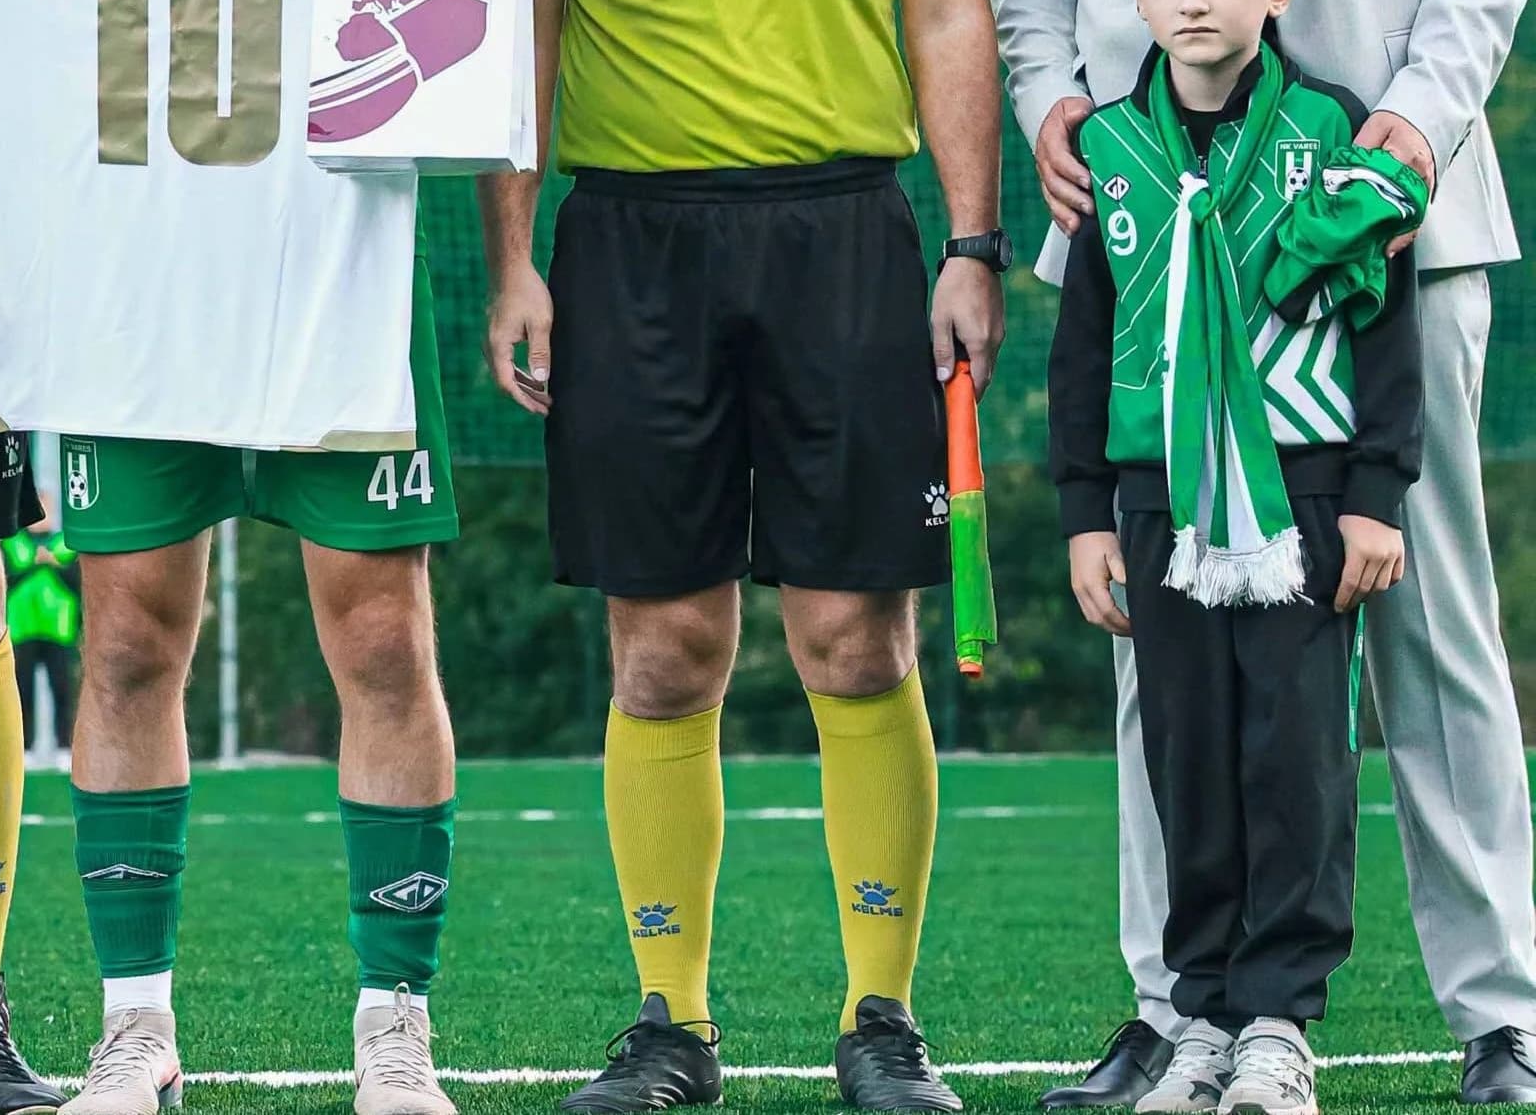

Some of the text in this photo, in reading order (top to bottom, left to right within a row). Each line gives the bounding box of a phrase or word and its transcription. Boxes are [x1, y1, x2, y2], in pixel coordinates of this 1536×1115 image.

[1107, 209, 1138, 257] 9
[367, 449, 435, 511] 44
[851, 902, 904, 917] KELME
[632, 924, 681, 938] KELME
